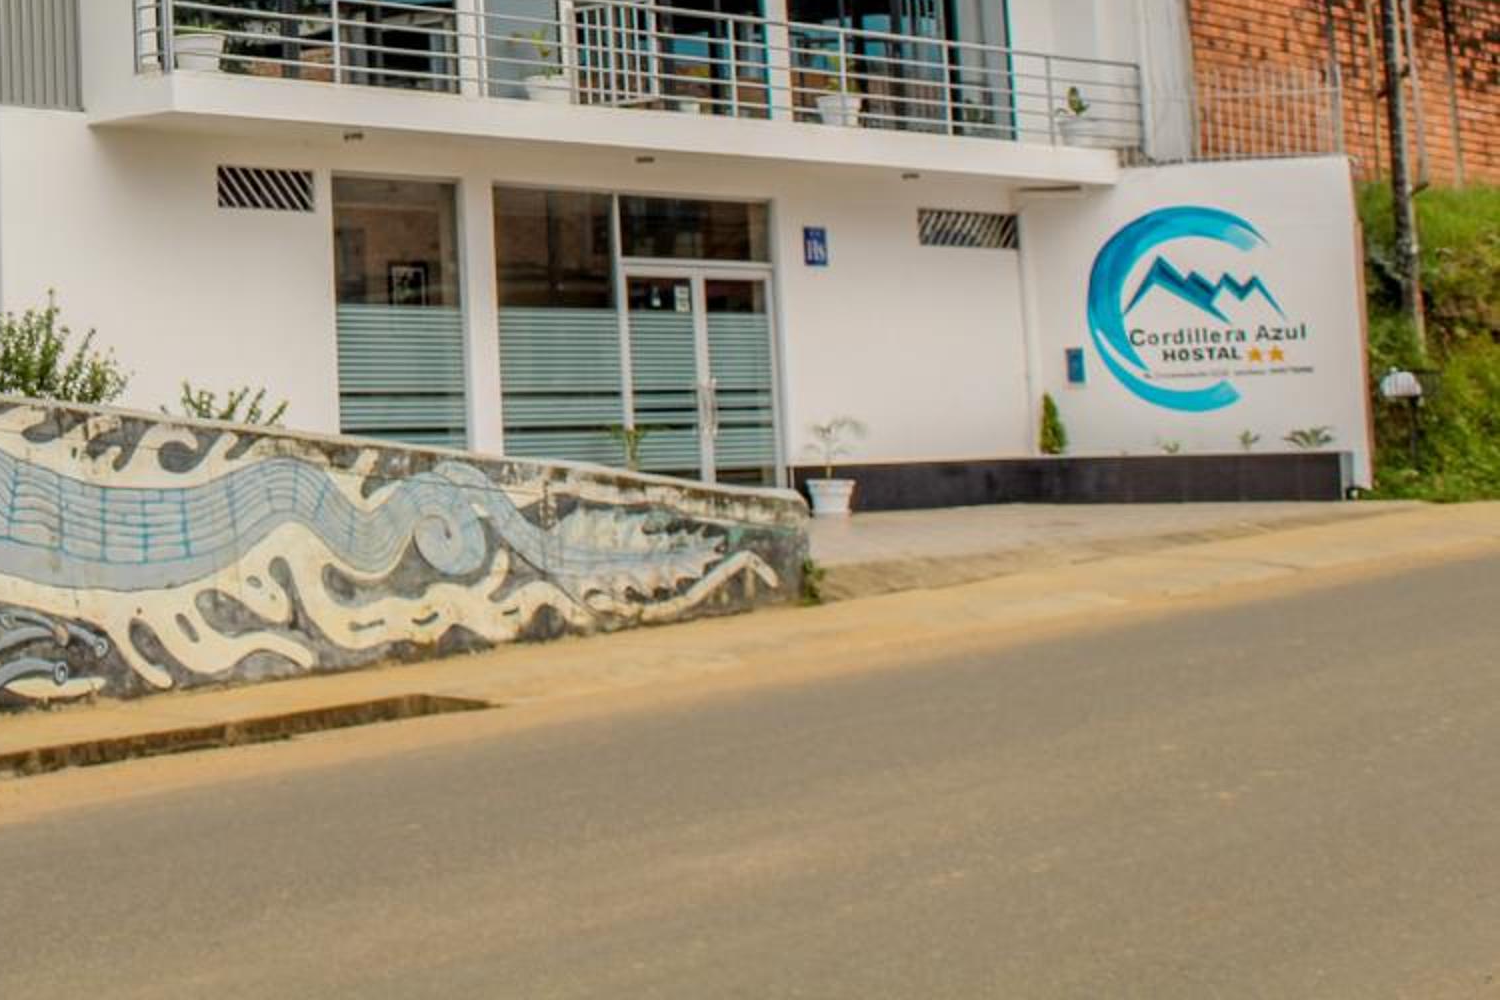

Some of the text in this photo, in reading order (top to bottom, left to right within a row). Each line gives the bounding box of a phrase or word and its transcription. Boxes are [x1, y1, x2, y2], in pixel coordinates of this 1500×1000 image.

[1129, 323, 1307, 347] Cordillera Azul
[1162, 347, 1242, 362] HOSTAL
